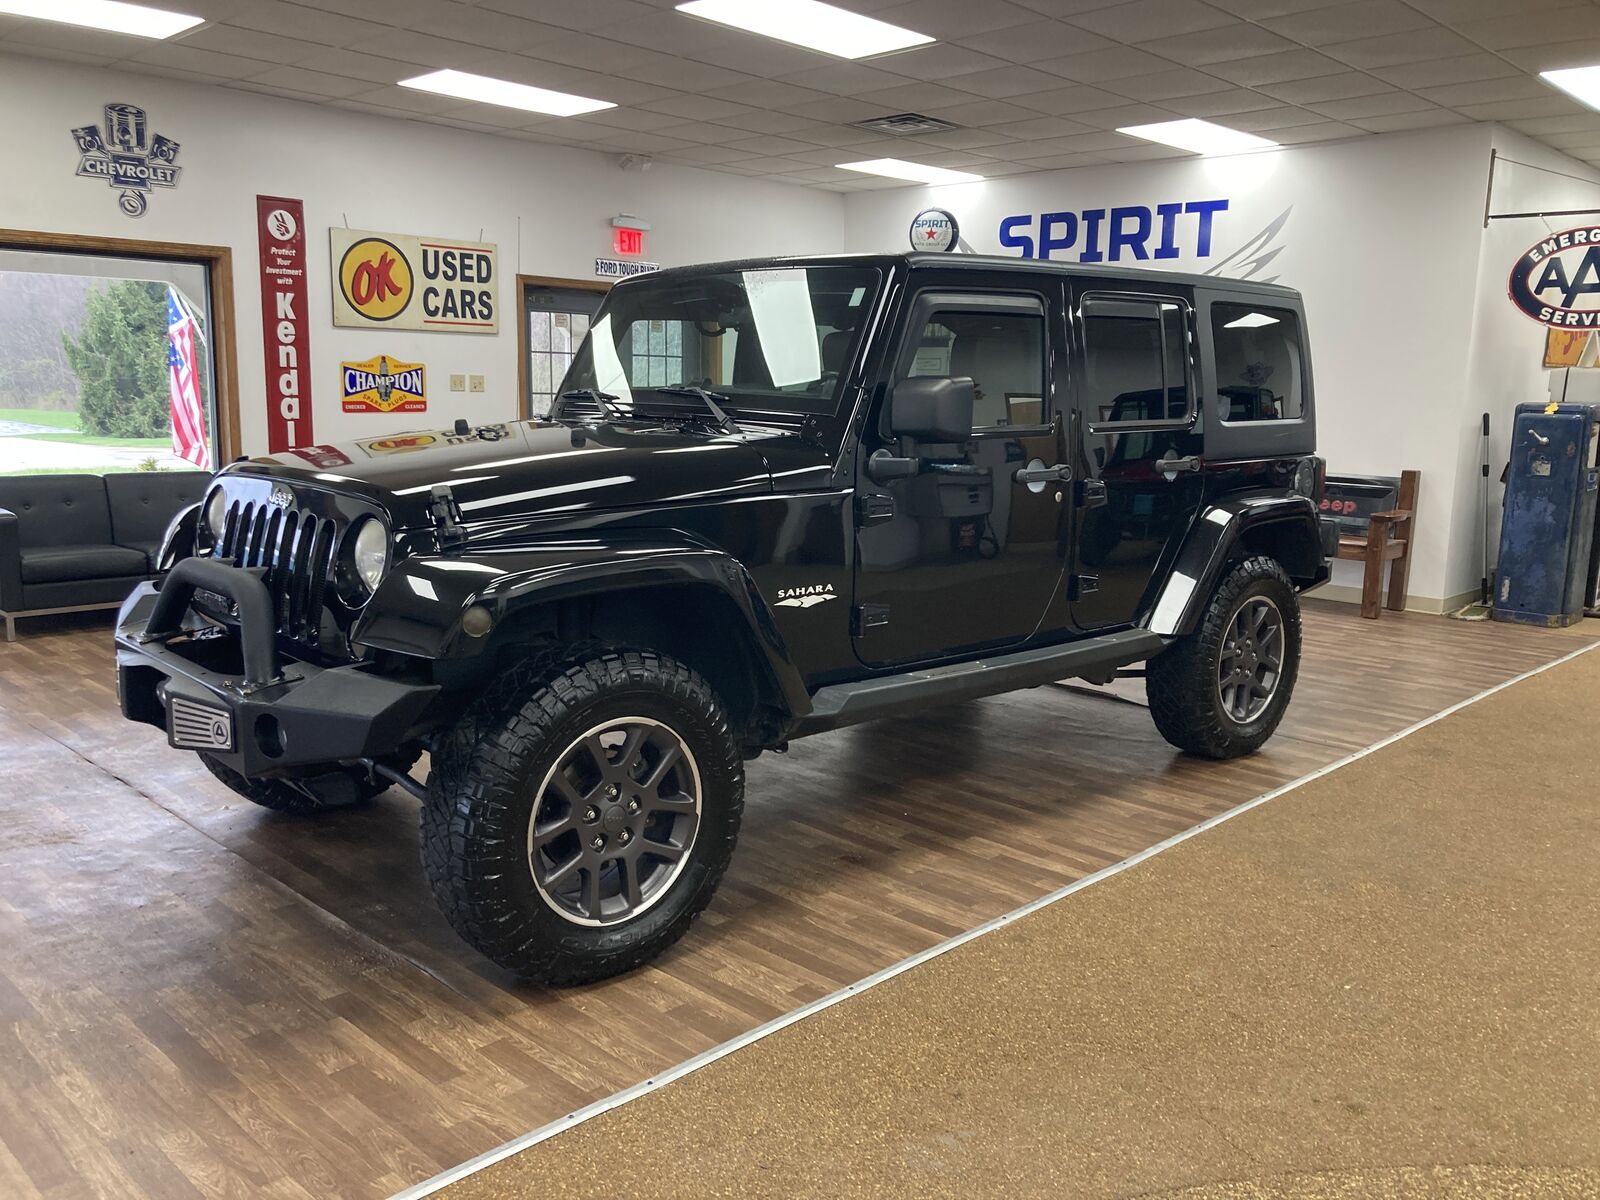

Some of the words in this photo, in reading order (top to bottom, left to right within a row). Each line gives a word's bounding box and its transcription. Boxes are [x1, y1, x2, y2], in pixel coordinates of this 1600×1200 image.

[85, 161, 173, 181] CHEVROLET
[914, 219, 950, 228] SPIRIT
[1000, 199, 1229, 262] SPIRIT
[620, 230, 642, 254] EXIT
[270, 247, 296, 256] Protect
[277, 257, 292, 265] Your
[422, 249, 492, 283] USED
[600, 261, 618, 274] FORD
[618, 263, 639, 275] TOUGH
[265, 266, 303, 276] Investment
[352, 251, 403, 306] OK
[277, 277, 293, 285] with
[423, 287, 493, 320] CARS
[275, 292, 300, 451] Kendal
[344, 369, 423, 394] CHAMPION
[362, 394, 382, 407] SPARK
[387, 394, 407, 408] PLUGS
[1319, 499, 1357, 515] eep
[777, 583, 834, 598] SAHARA
